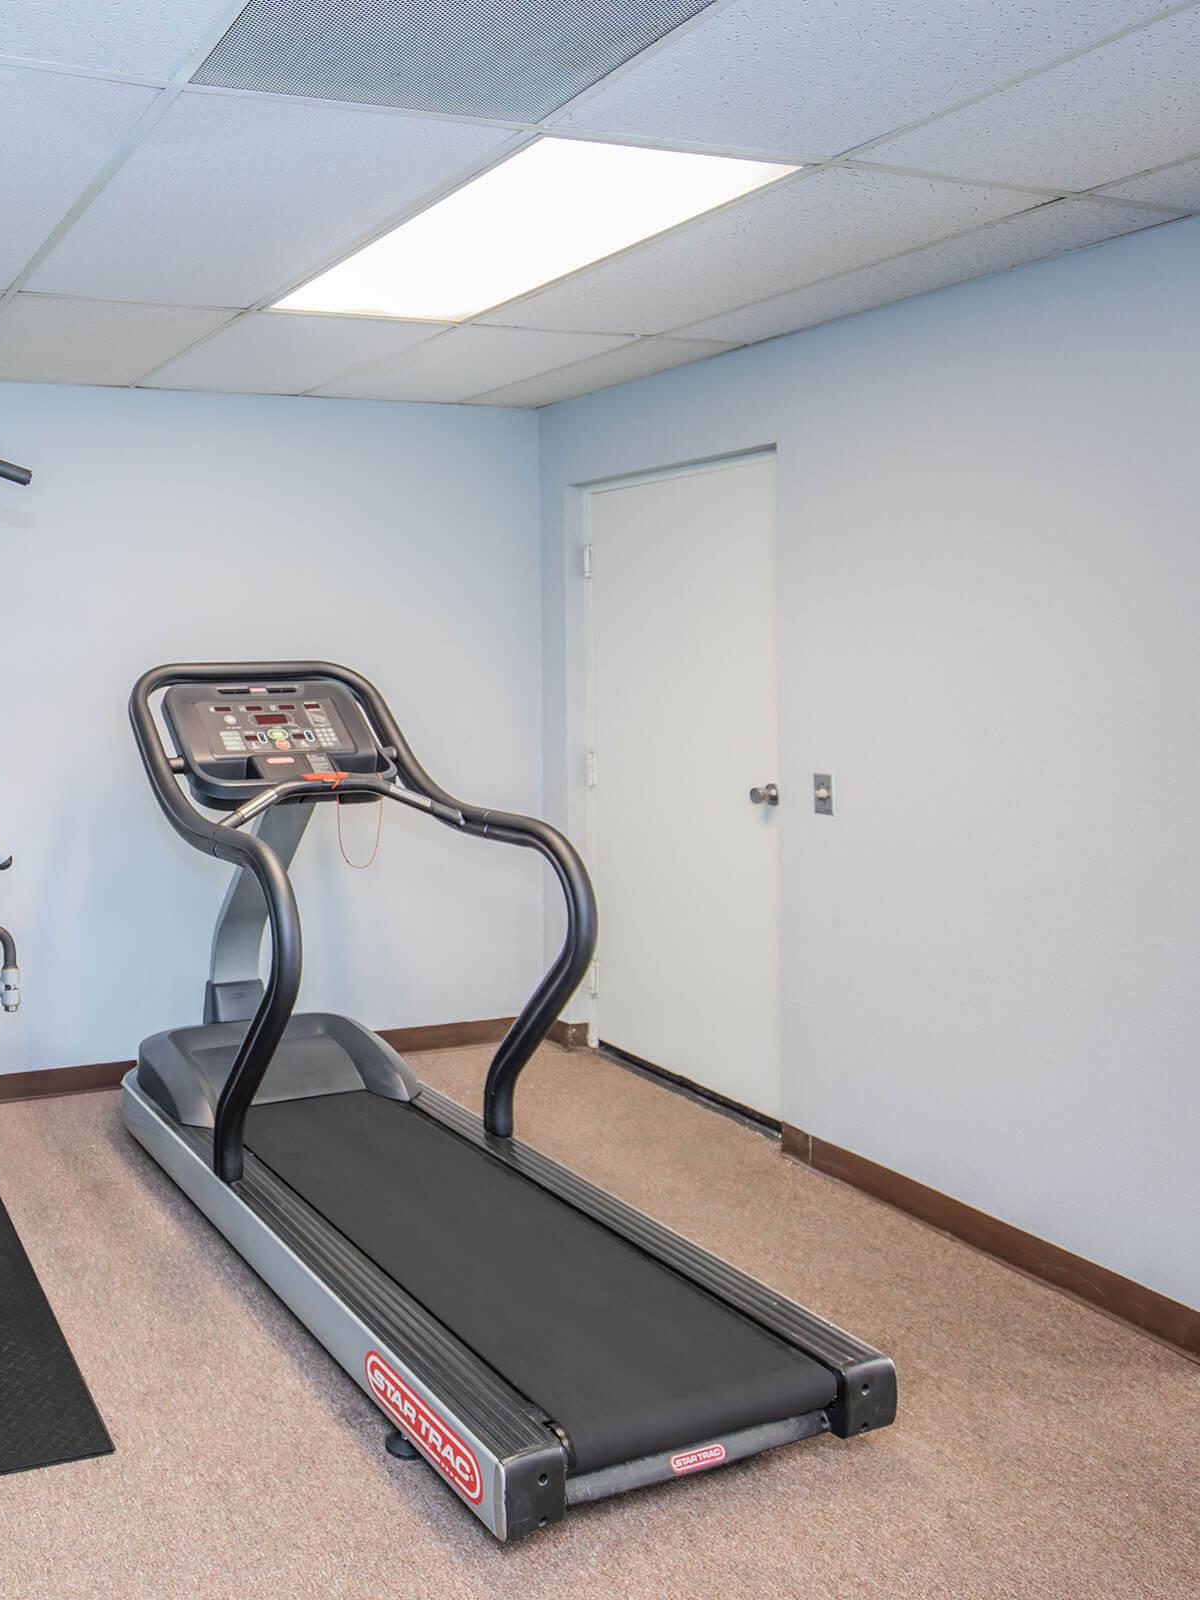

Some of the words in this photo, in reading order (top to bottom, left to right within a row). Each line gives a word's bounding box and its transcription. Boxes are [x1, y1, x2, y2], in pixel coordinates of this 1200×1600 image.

[371, 1368, 417, 1425] STAR
[418, 1416, 471, 1482] TRAC
[674, 1455, 698, 1467] STAR
[696, 1448, 721, 1461] TRAC
